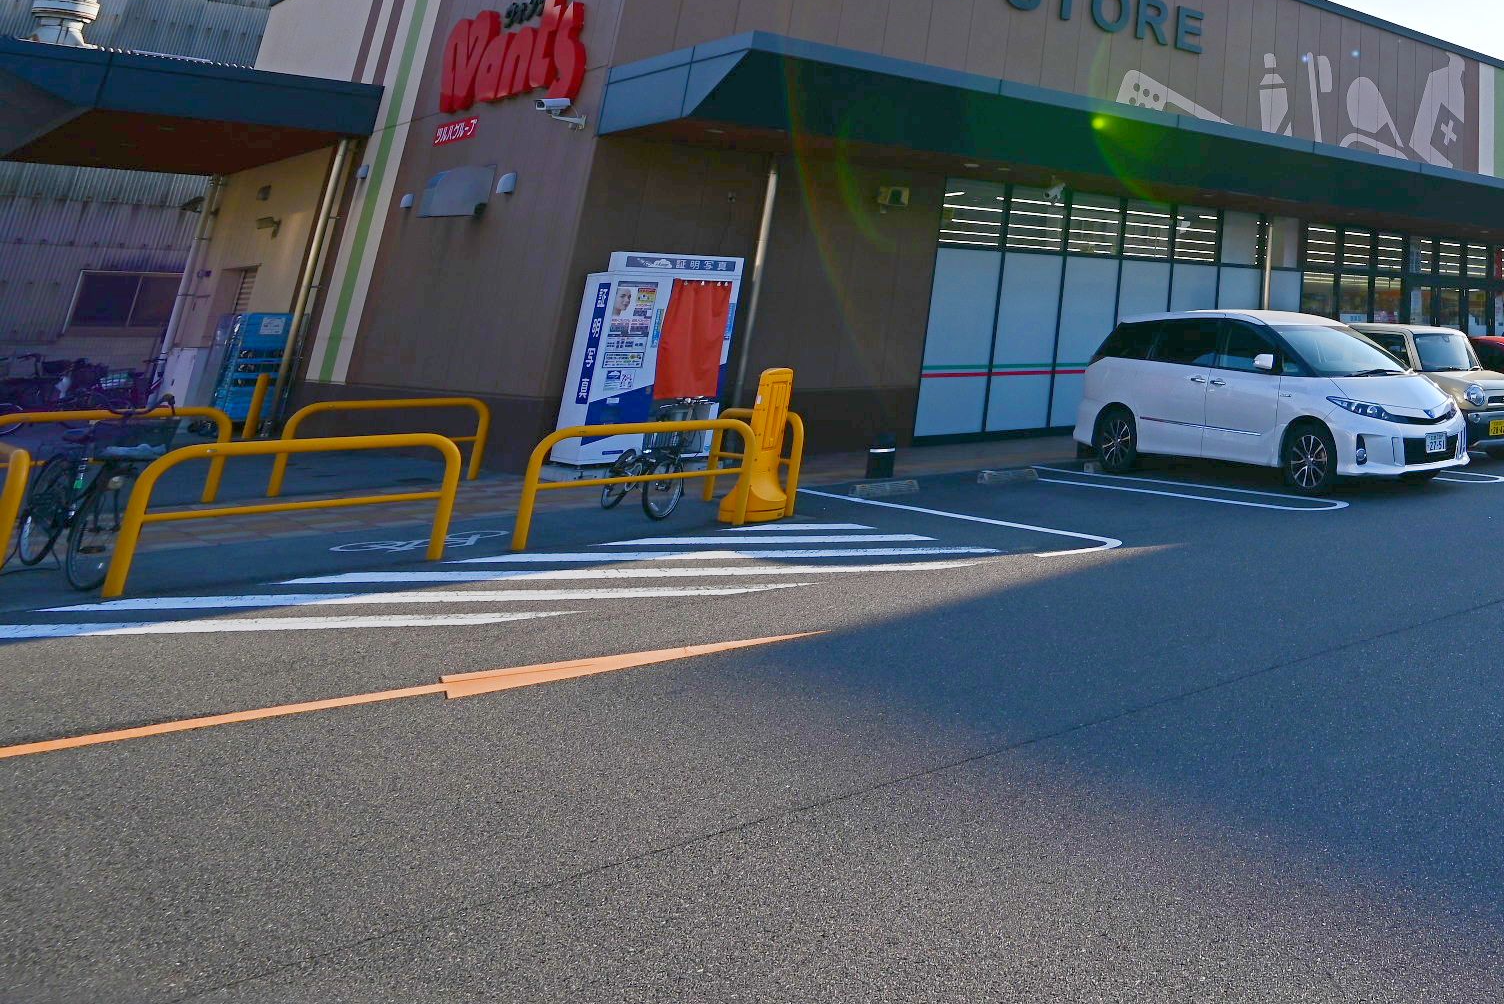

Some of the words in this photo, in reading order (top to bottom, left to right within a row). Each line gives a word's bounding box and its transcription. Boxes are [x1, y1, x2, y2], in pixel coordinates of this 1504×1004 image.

[434, 119, 478, 144] ツルハグループ
[675, 259, 728, 271] 証明写真
